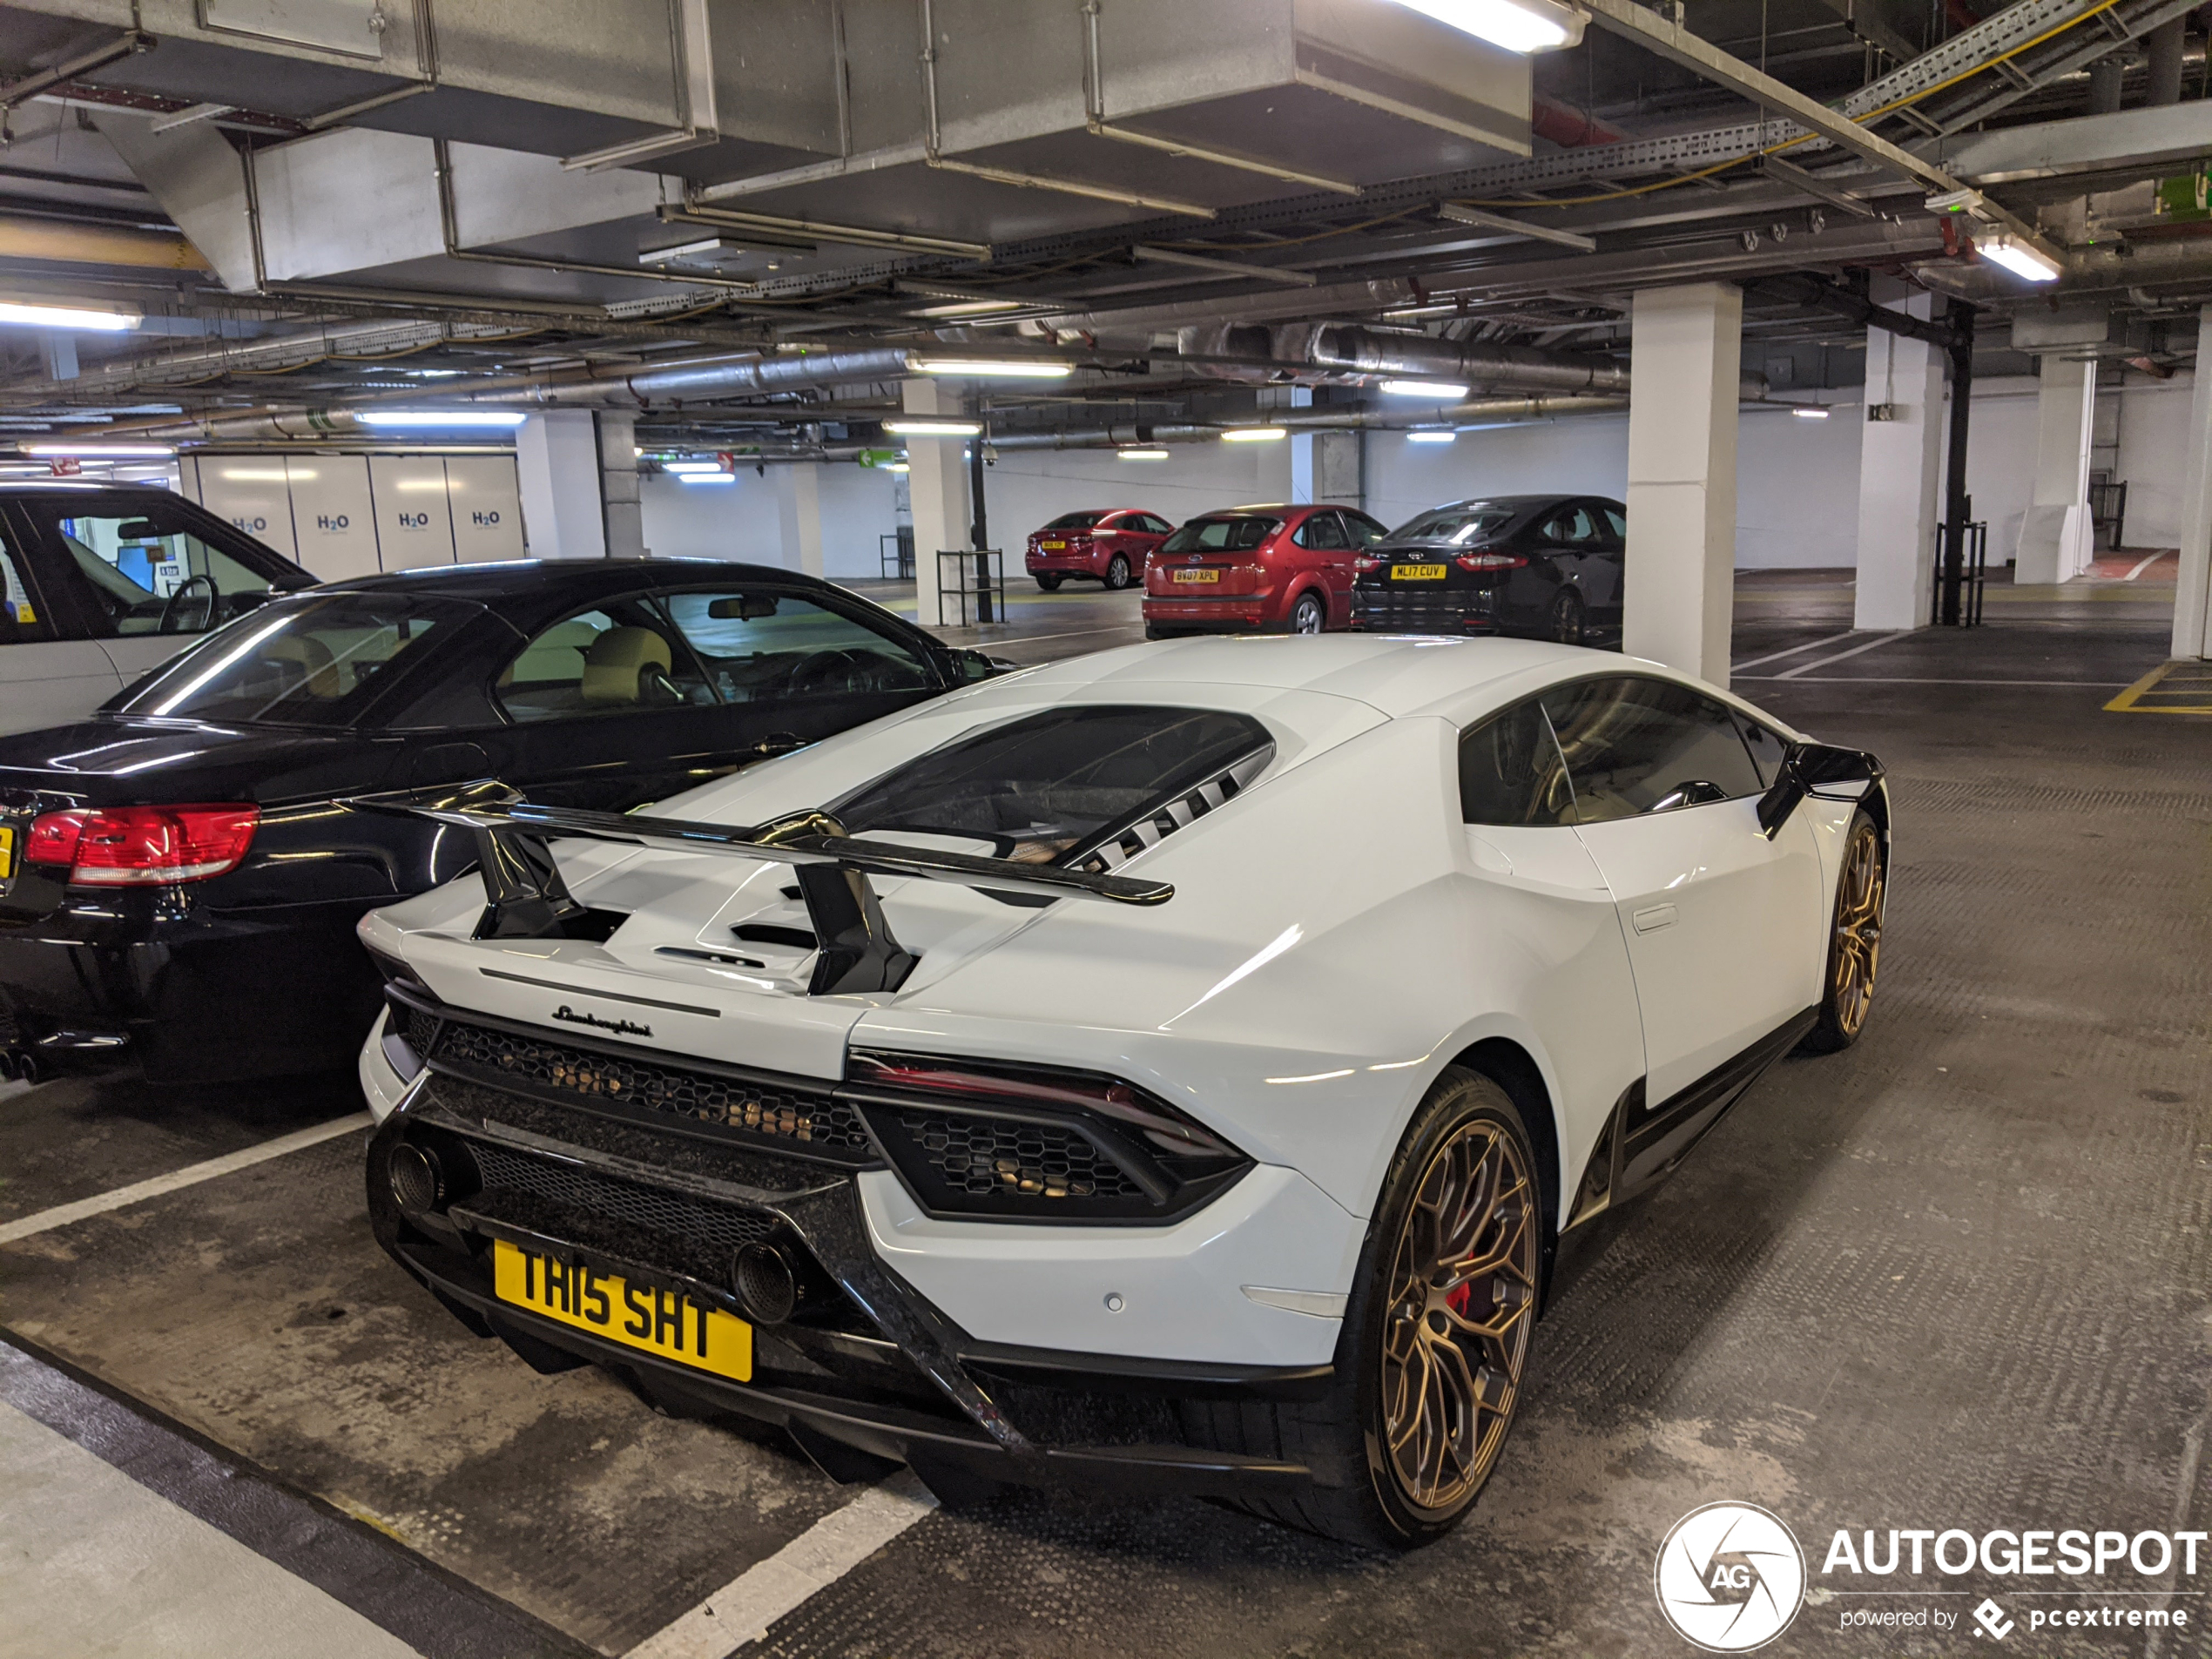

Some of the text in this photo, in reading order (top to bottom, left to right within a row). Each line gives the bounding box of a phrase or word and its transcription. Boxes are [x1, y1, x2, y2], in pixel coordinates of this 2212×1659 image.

[317, 515, 349, 530] H2O
[399, 512, 428, 528] H2O
[472, 510, 500, 525] H2O
[1199, 570, 1215, 580] XPL
[1397, 565, 1440, 577] ML17 CUV
[551, 1005, 654, 1038] Lamborghini
[623, 1278, 716, 1359] SHT
